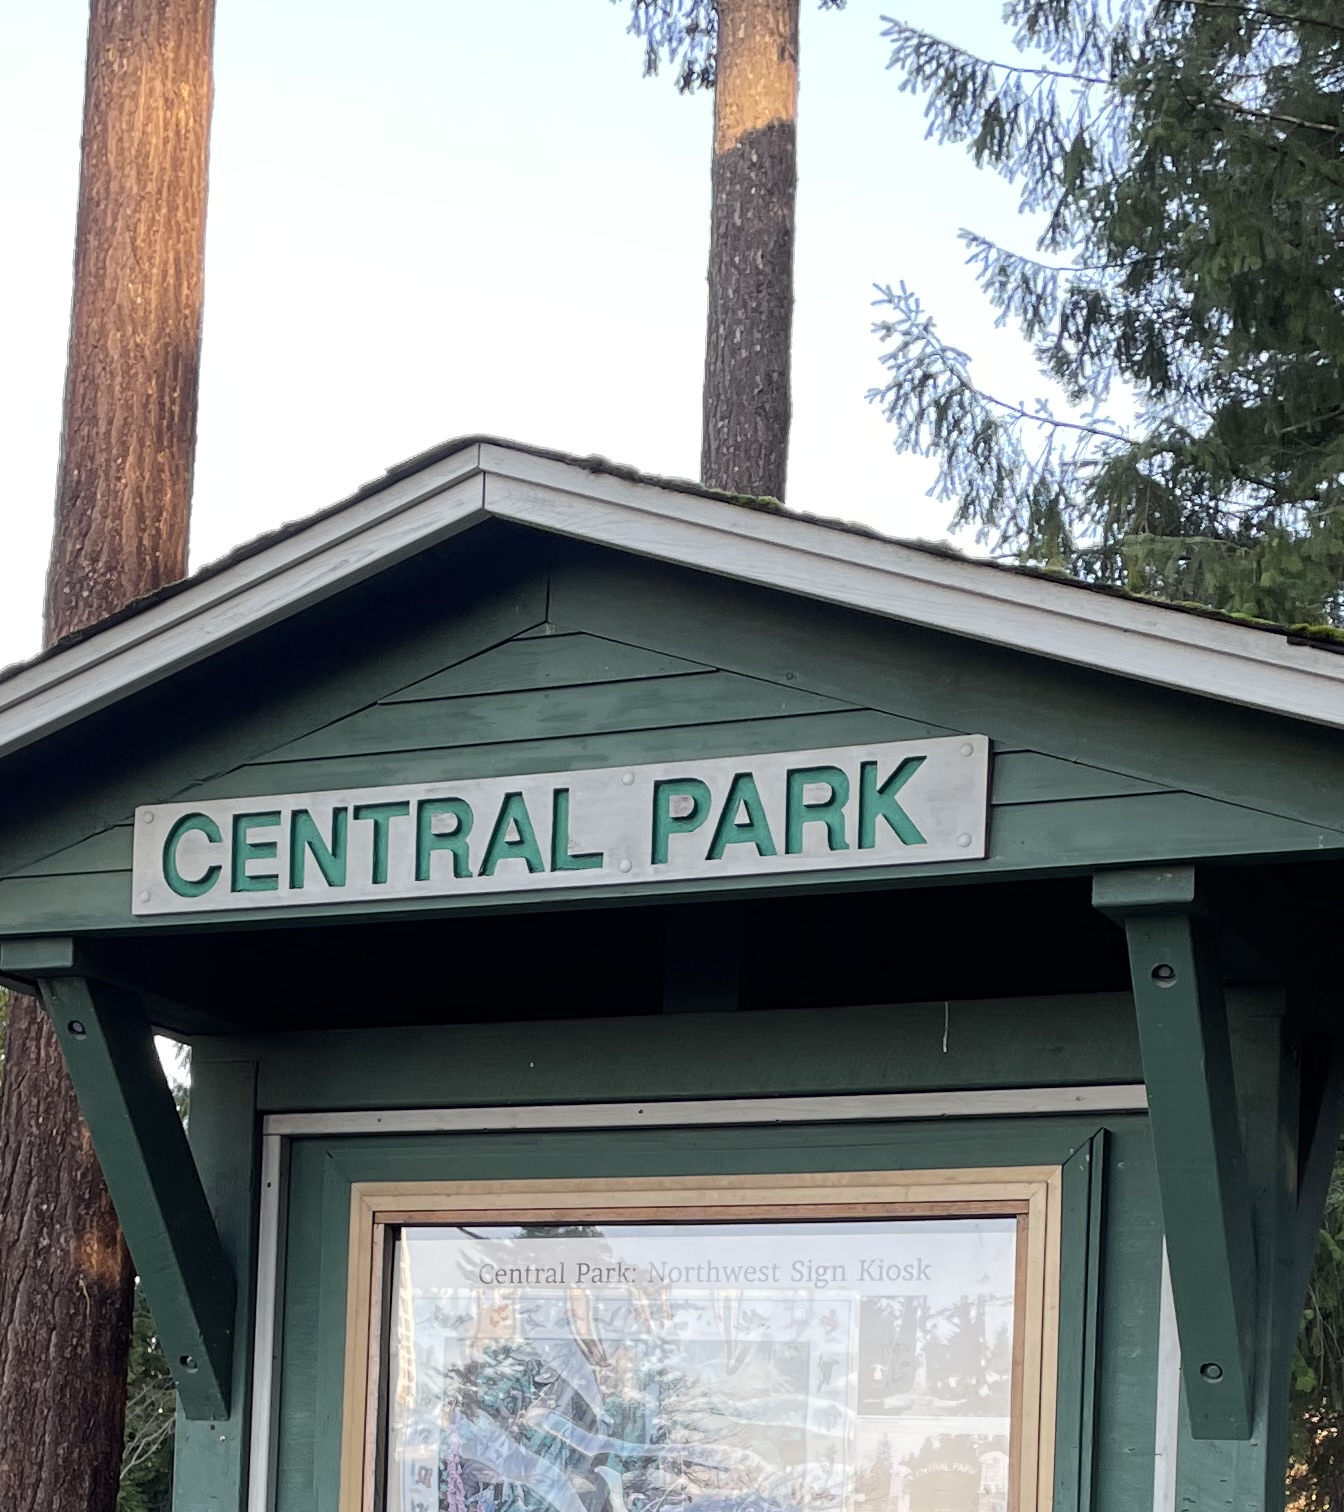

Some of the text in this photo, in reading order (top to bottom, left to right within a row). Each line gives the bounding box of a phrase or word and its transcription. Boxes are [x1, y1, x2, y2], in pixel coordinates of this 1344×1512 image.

[161, 755, 928, 899] CENTRAL PARK
[478, 1257, 932, 1289] Central Park: Northwest Sign Kiosk
